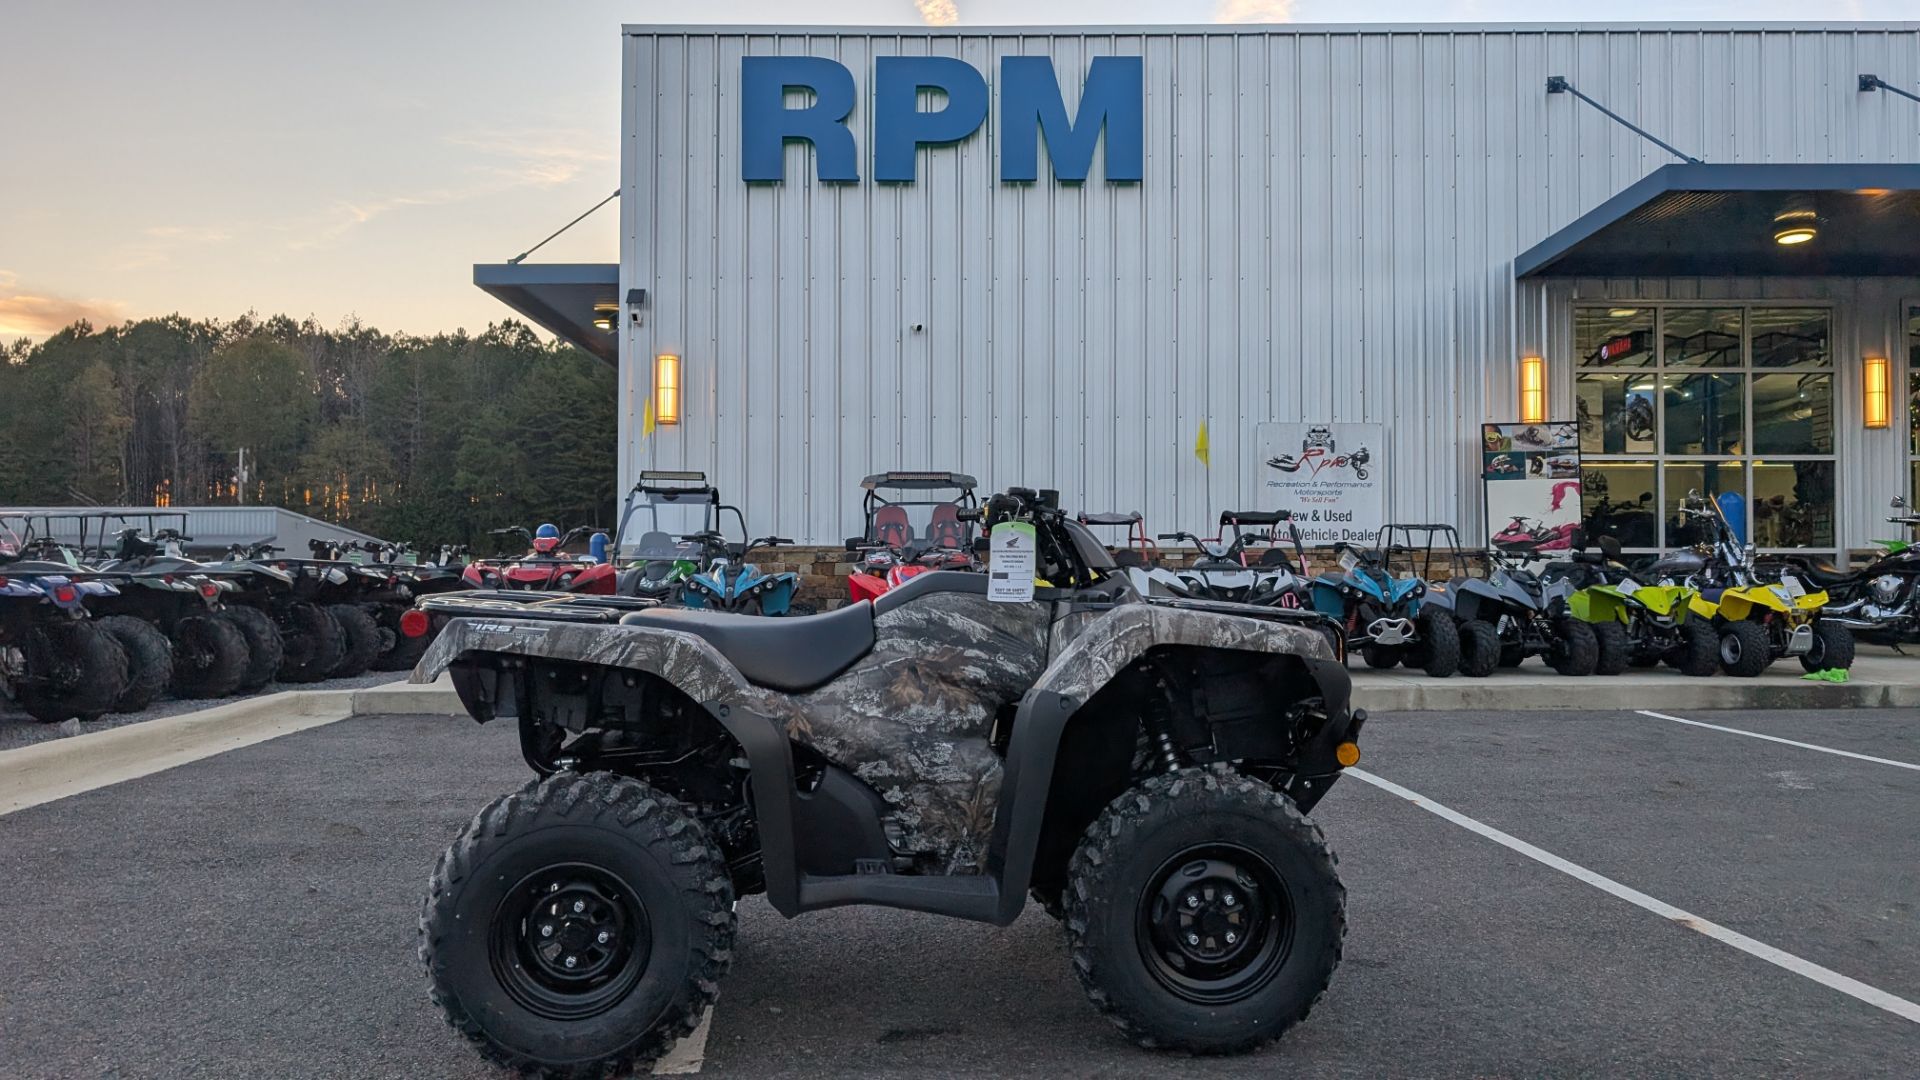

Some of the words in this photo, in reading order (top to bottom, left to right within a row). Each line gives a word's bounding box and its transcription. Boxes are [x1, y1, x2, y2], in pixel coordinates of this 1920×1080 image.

[742, 56, 1143, 181] RPM
[1288, 509, 1308, 521] ew
[1311, 510, 1320, 521] &
[1324, 510, 1352, 521] Used
[1260, 528, 1289, 540] Moto
[1297, 528, 1338, 540] Vehicle
[1342, 529, 1380, 541] Dealer
[475, 623, 513, 632] IRS
